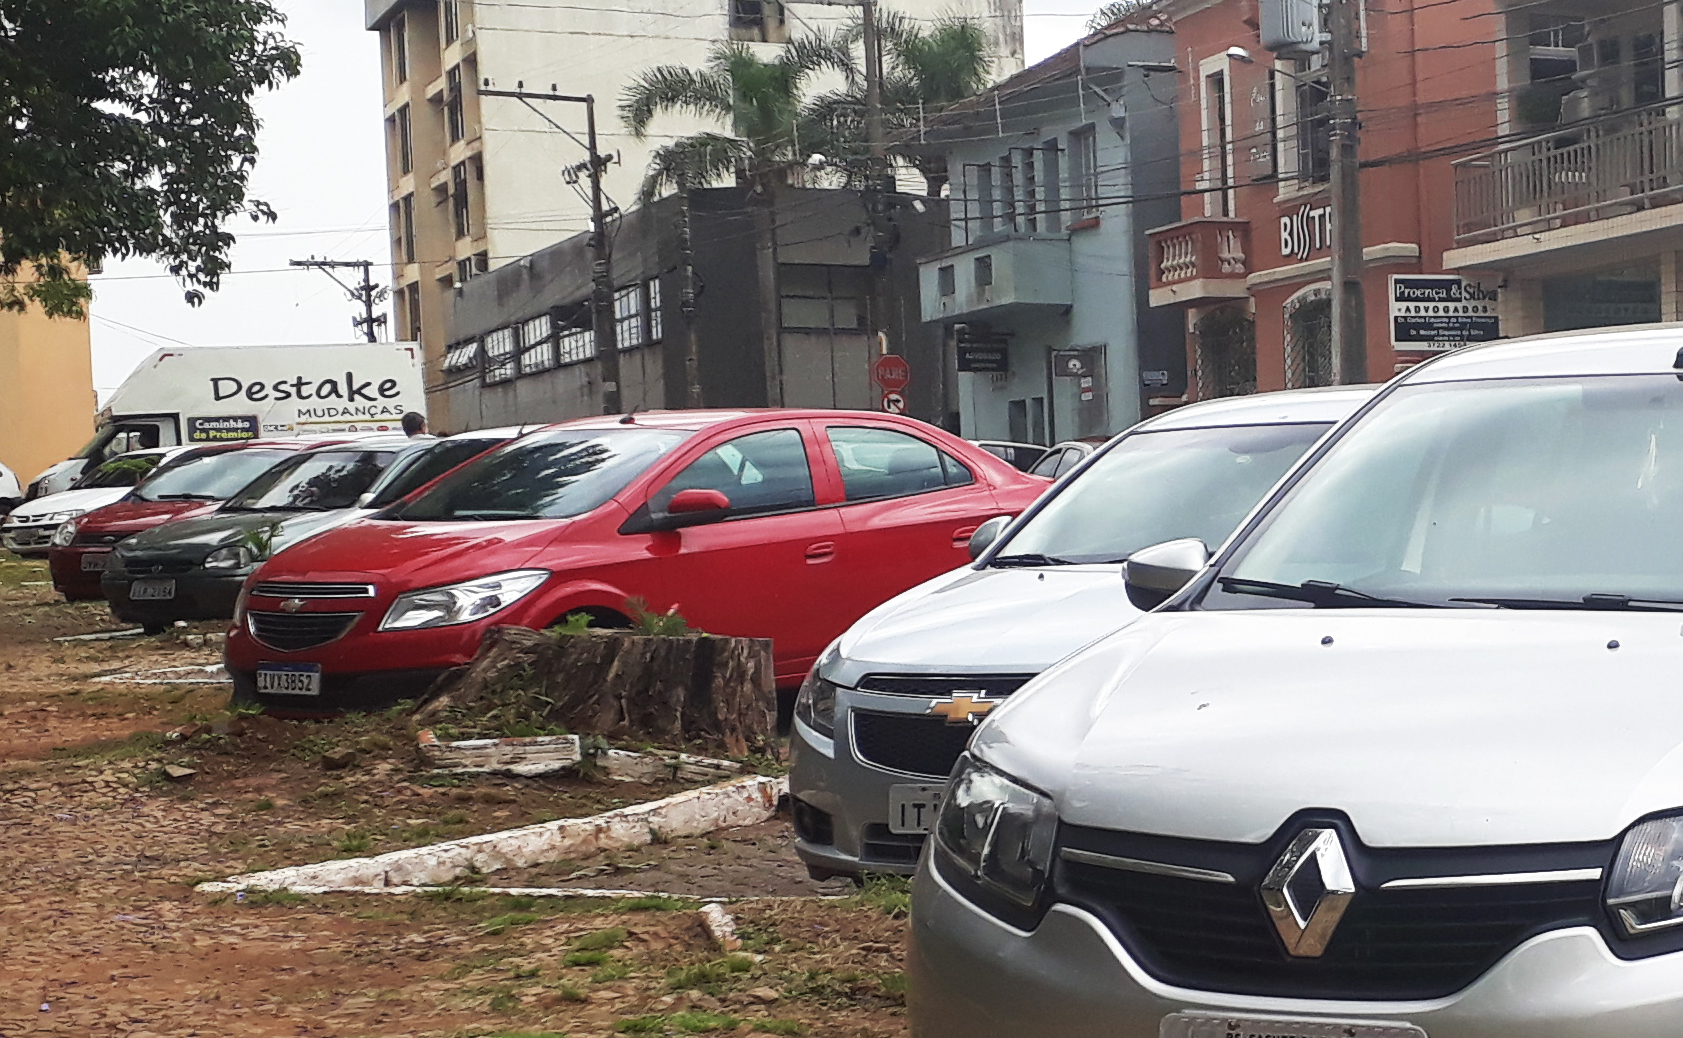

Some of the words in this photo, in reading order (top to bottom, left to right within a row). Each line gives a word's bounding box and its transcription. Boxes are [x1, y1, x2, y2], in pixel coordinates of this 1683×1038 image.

[1396, 284, 1447, 301] Proença
[1450, 284, 1461, 298] &
[1463, 281, 1498, 301] Silva
[1404, 305, 1488, 314] ADVOGADOS
[878, 366, 906, 380] PARE
[209, 371, 401, 402] Destake
[297, 404, 404, 418] MUDANÇAS
[195, 417, 250, 429] Caminhão
[193, 430, 207, 439] de
[209, 428, 254, 439] Prêmios
